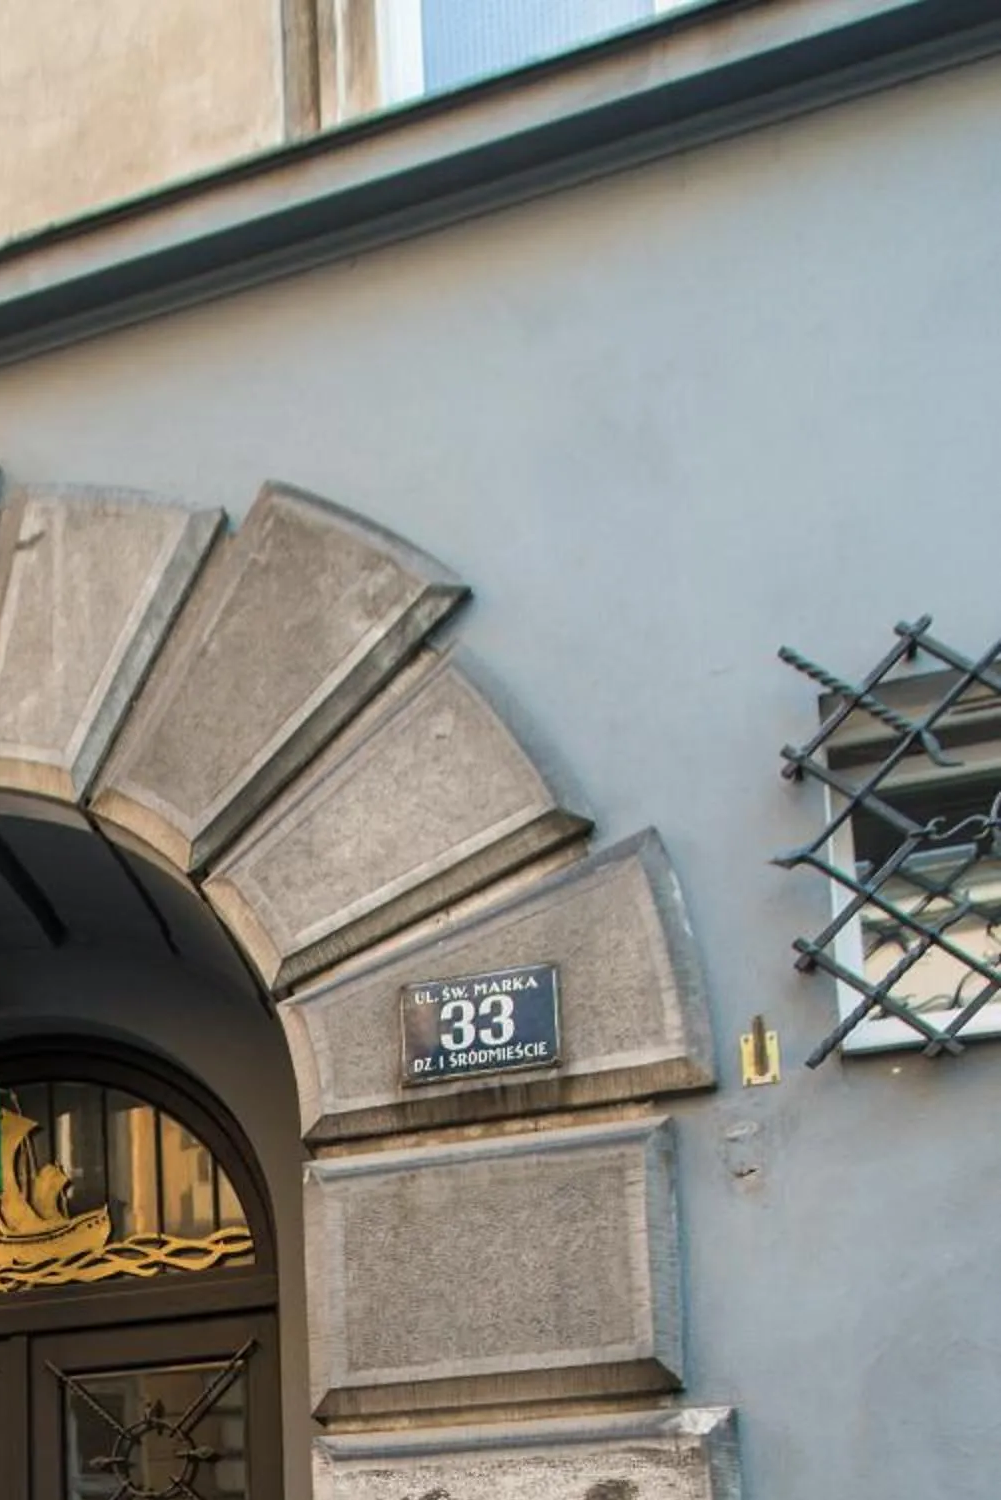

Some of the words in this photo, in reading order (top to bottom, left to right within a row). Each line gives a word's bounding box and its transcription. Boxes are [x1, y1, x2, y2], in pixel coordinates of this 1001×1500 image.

[414, 991, 439, 1005] UL.
[442, 987, 468, 1001] ŚW.
[474, 976, 538, 996] MARKA
[440, 994, 515, 1050] 33
